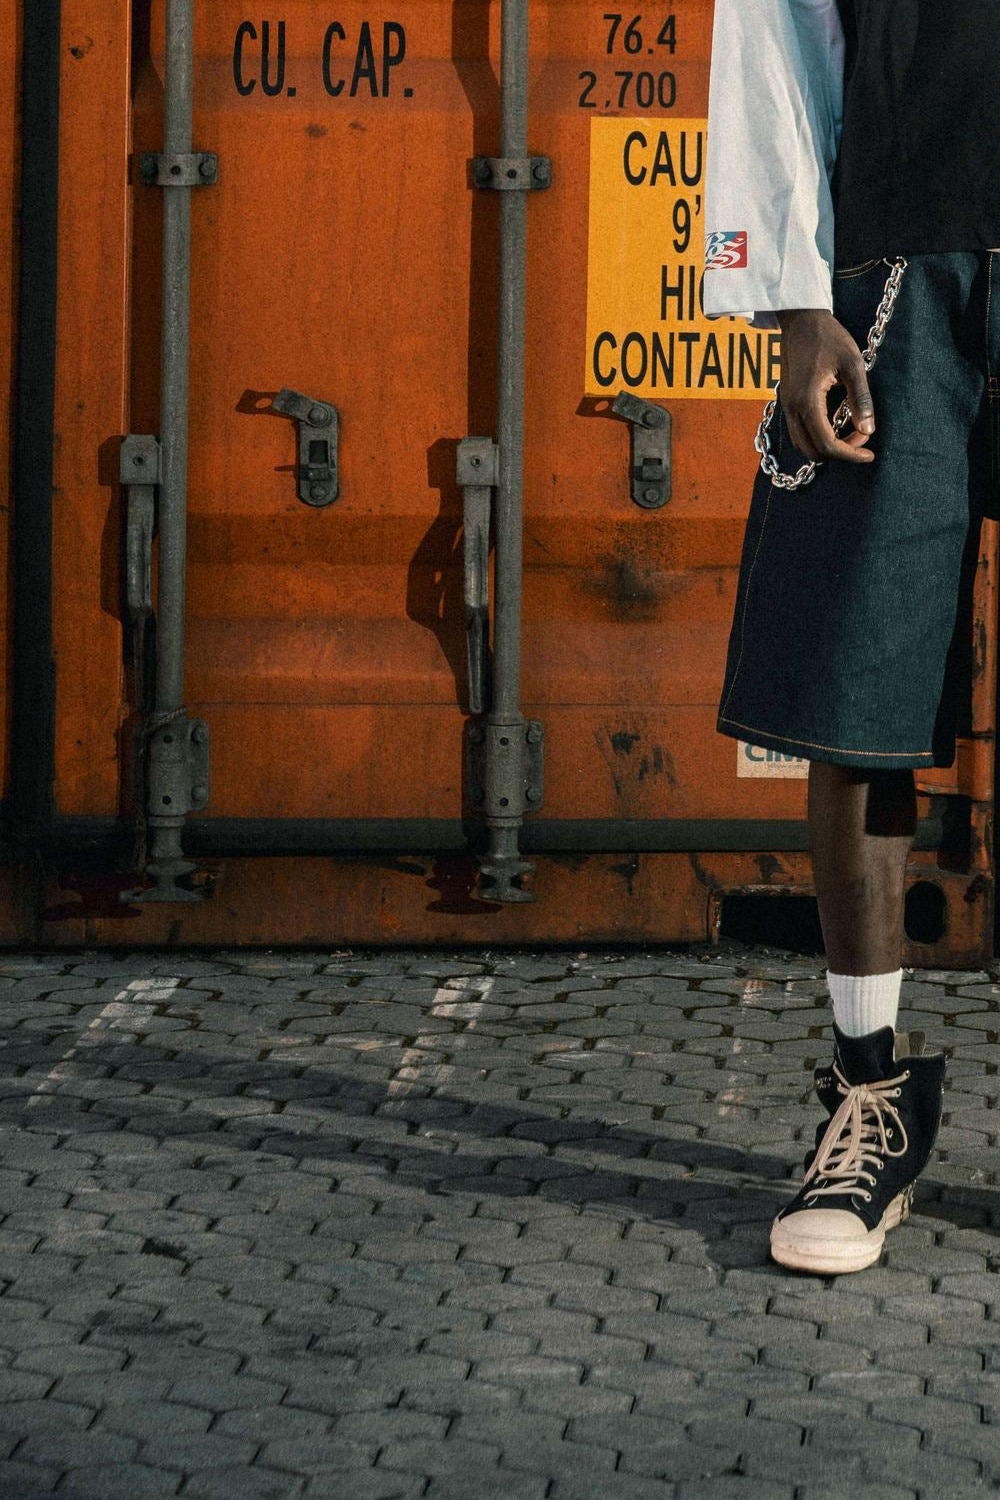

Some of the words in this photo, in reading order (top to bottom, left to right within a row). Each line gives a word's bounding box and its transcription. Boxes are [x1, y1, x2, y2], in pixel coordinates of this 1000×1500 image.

[233, 21, 297, 97] CU.
[322, 21, 414, 98] CAP.
[603, 13, 678, 55] 76.4
[623, 130, 709, 187] CAU
